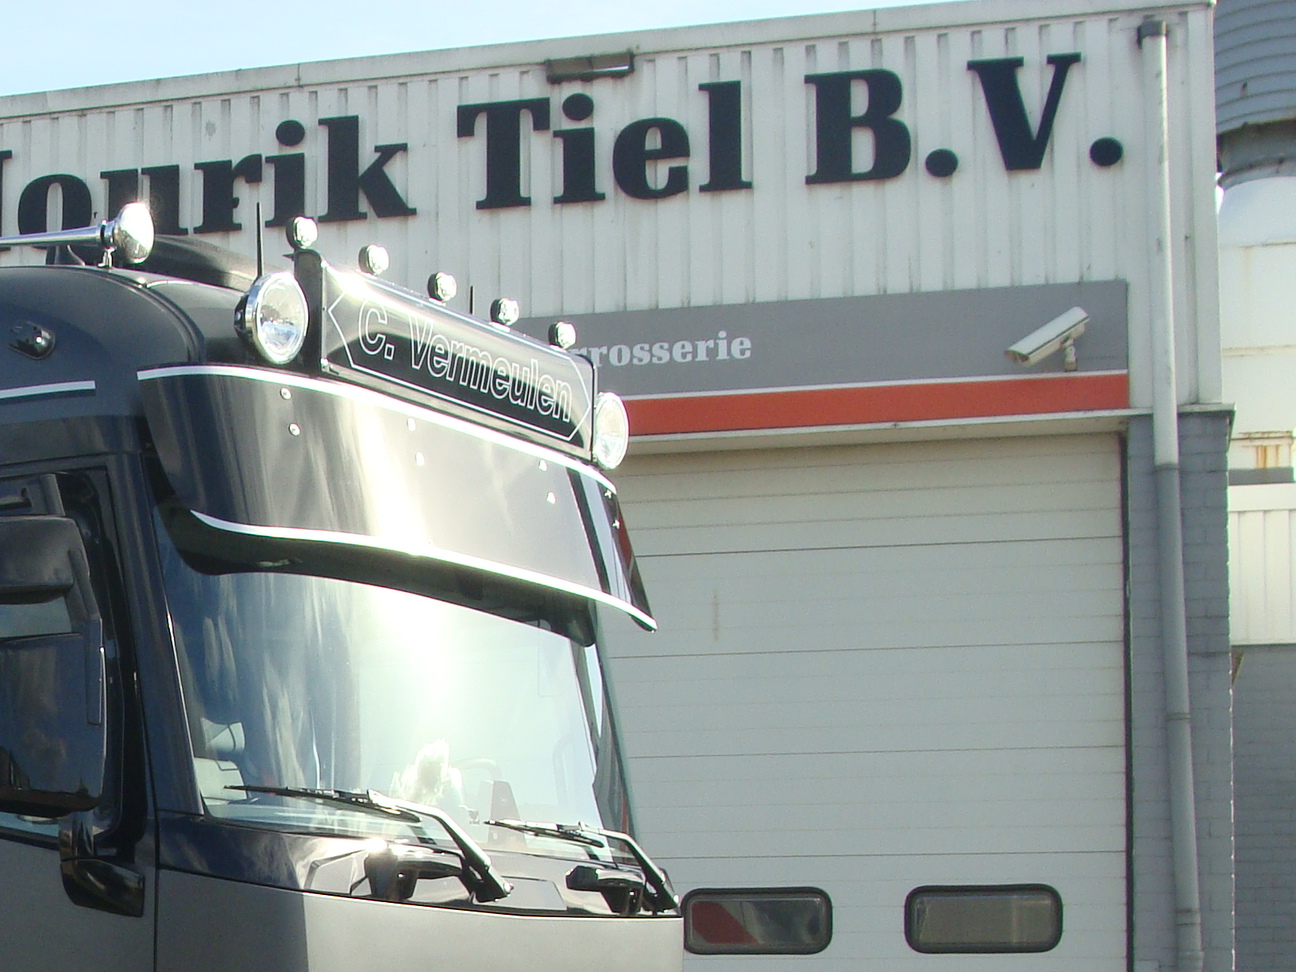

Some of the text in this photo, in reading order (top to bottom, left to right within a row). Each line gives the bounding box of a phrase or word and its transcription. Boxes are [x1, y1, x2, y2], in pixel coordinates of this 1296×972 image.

[457, 80, 753, 210] Tiel
[804, 52, 1124, 185] B.V.
[358, 299, 572, 423] C. Vermeulen
